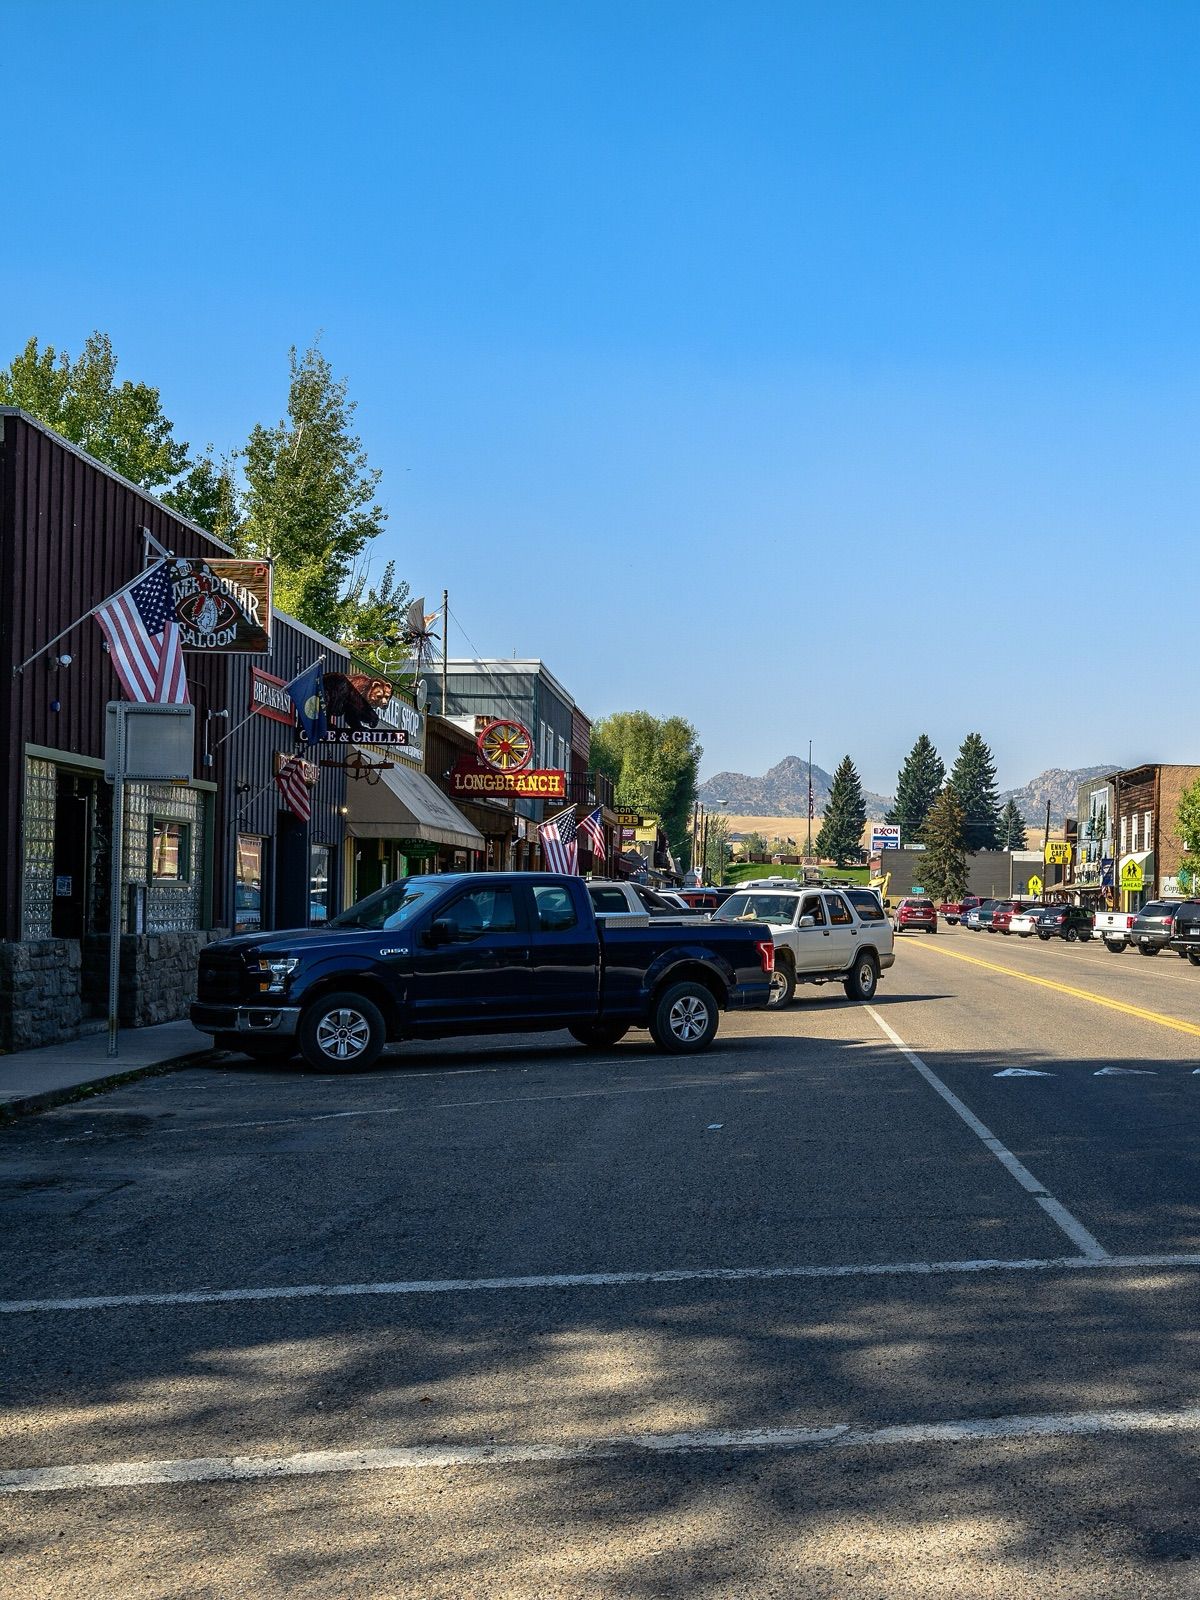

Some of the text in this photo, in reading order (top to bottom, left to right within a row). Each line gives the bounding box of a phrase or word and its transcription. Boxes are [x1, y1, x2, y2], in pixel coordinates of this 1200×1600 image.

[179, 621, 238, 648] SALOON
[401, 706, 419, 738] SHOP
[340, 732, 349, 742] &
[352, 731, 406, 744] GRILLE
[454, 773, 560, 792] LONGBRANCH
[873, 827, 899, 837] EXXON
[1050, 843, 1069, 851] ENNIS
